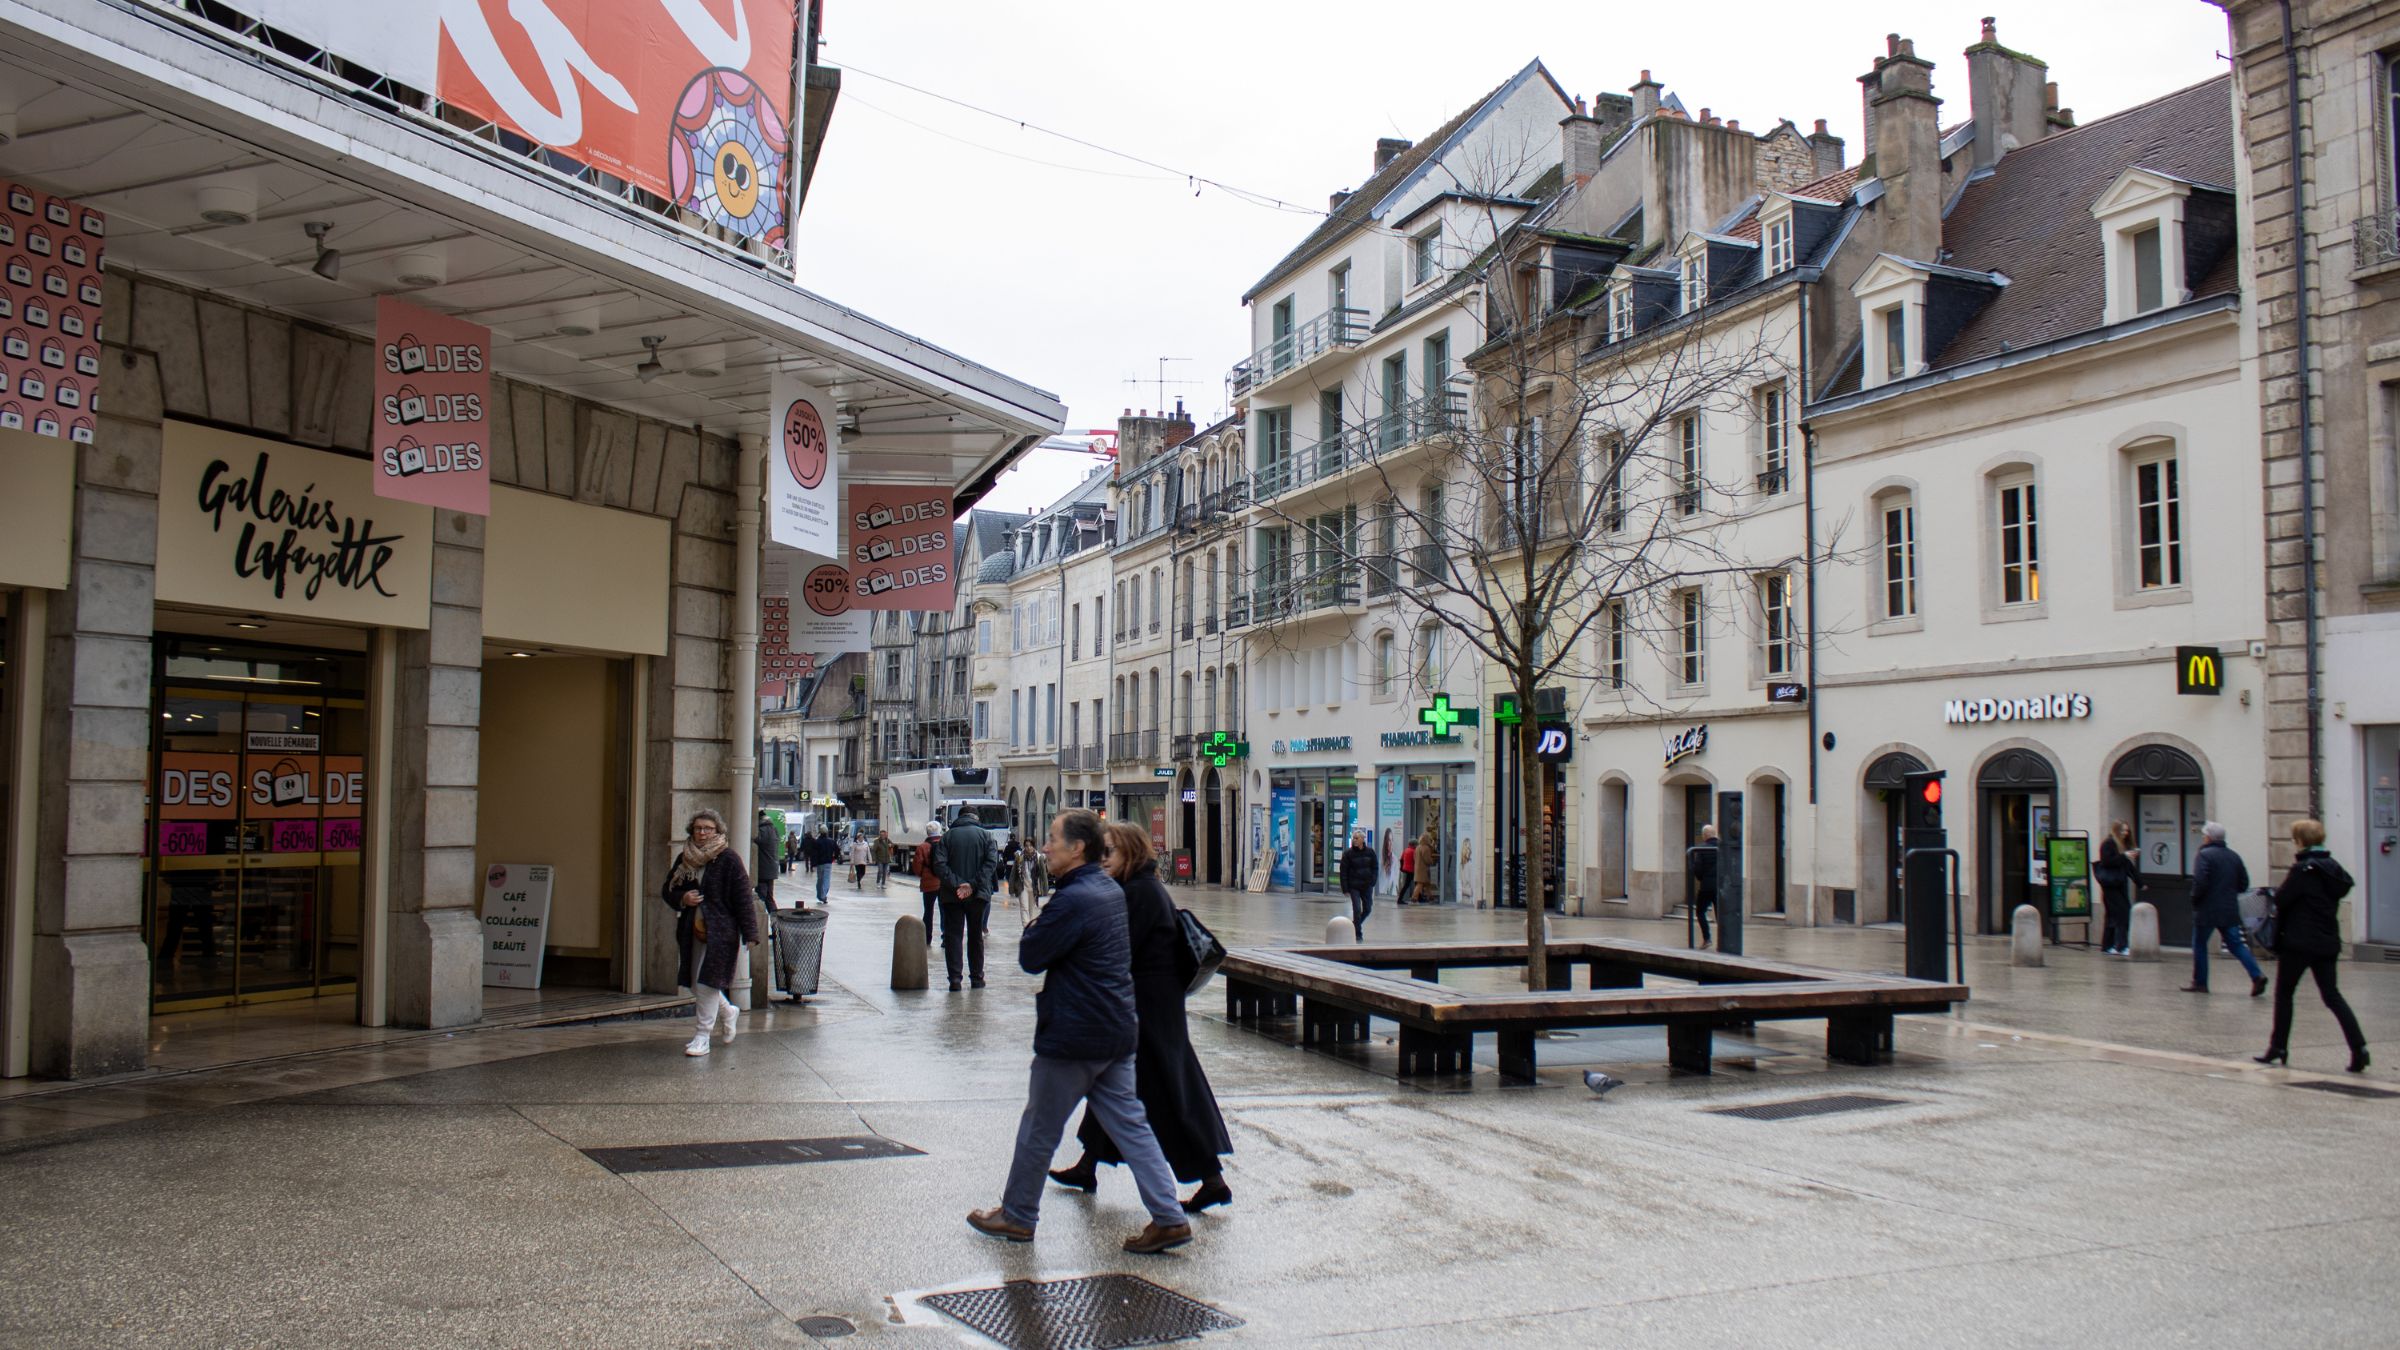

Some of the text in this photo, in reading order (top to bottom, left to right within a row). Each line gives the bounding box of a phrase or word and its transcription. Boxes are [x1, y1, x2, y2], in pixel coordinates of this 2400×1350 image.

[787, 421, 825, 454] -50%
[198, 452, 339, 533] Galeries
[234, 517, 405, 601] Lafayette
[807, 578, 849, 593] -50%
[1944, 693, 2090, 723] McDonald's
[250, 735, 317, 748] NOUVELLE DÉMARQUE
[1380, 730, 1429, 748] PHARMACIE
[1537, 730, 1567, 754] JD
[1664, 724, 1708, 763] McCafé
[162, 832, 205, 853] -60%
[276, 830, 314, 850] -60%
[325, 829, 361, 849] -60%
[488, 871, 506, 882] NEW
[503, 890, 527, 902] CAFÉ
[486, 914, 539, 927] COLLAGÈNE
[492, 939, 526, 952] BEAUTÉ
